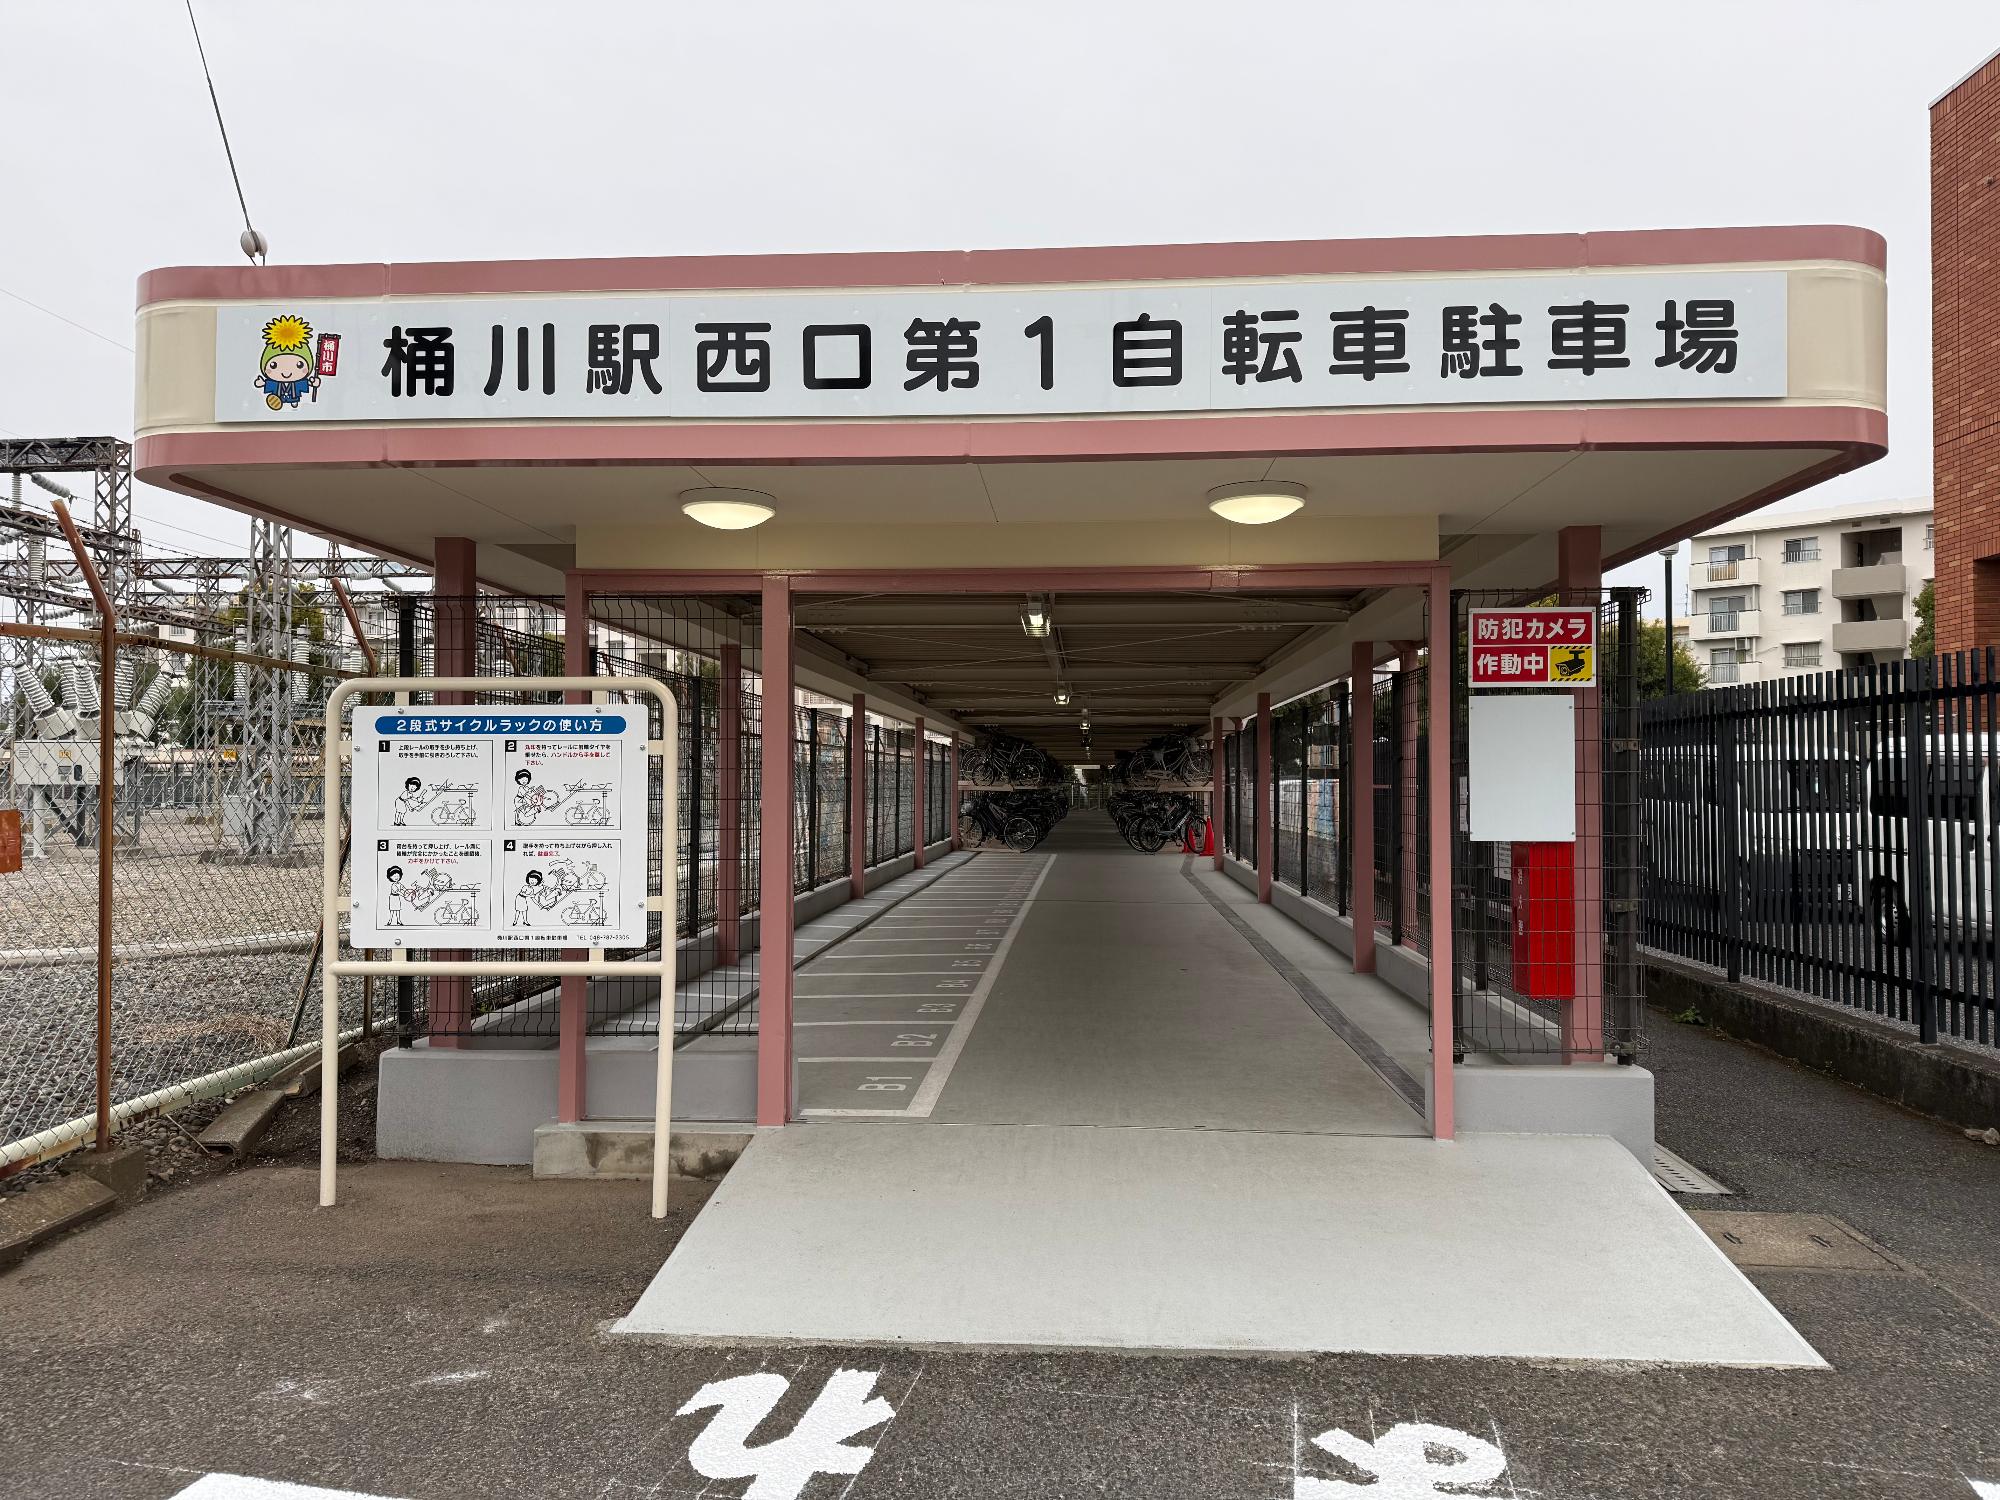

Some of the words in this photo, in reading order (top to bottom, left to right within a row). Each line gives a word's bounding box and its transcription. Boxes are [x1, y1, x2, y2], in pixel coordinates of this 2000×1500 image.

[381, 299, 1739, 398] 桶川駅西口第1自転車駐車場
[321, 339, 335, 373] 桶川市
[1477, 617, 1587, 640] 防犯カメラ
[1476, 652, 1544, 675] 作動中
[396, 718, 603, 732] 2段式サイクルラックの使い方
[507, 742, 515, 751] 2
[379, 841, 387, 850] 3
[506, 841, 514, 850] 4
[916, 1003, 956, 1013] B3
[890, 1033, 938, 1047] B2
[856, 1076, 913, 1091] B1
